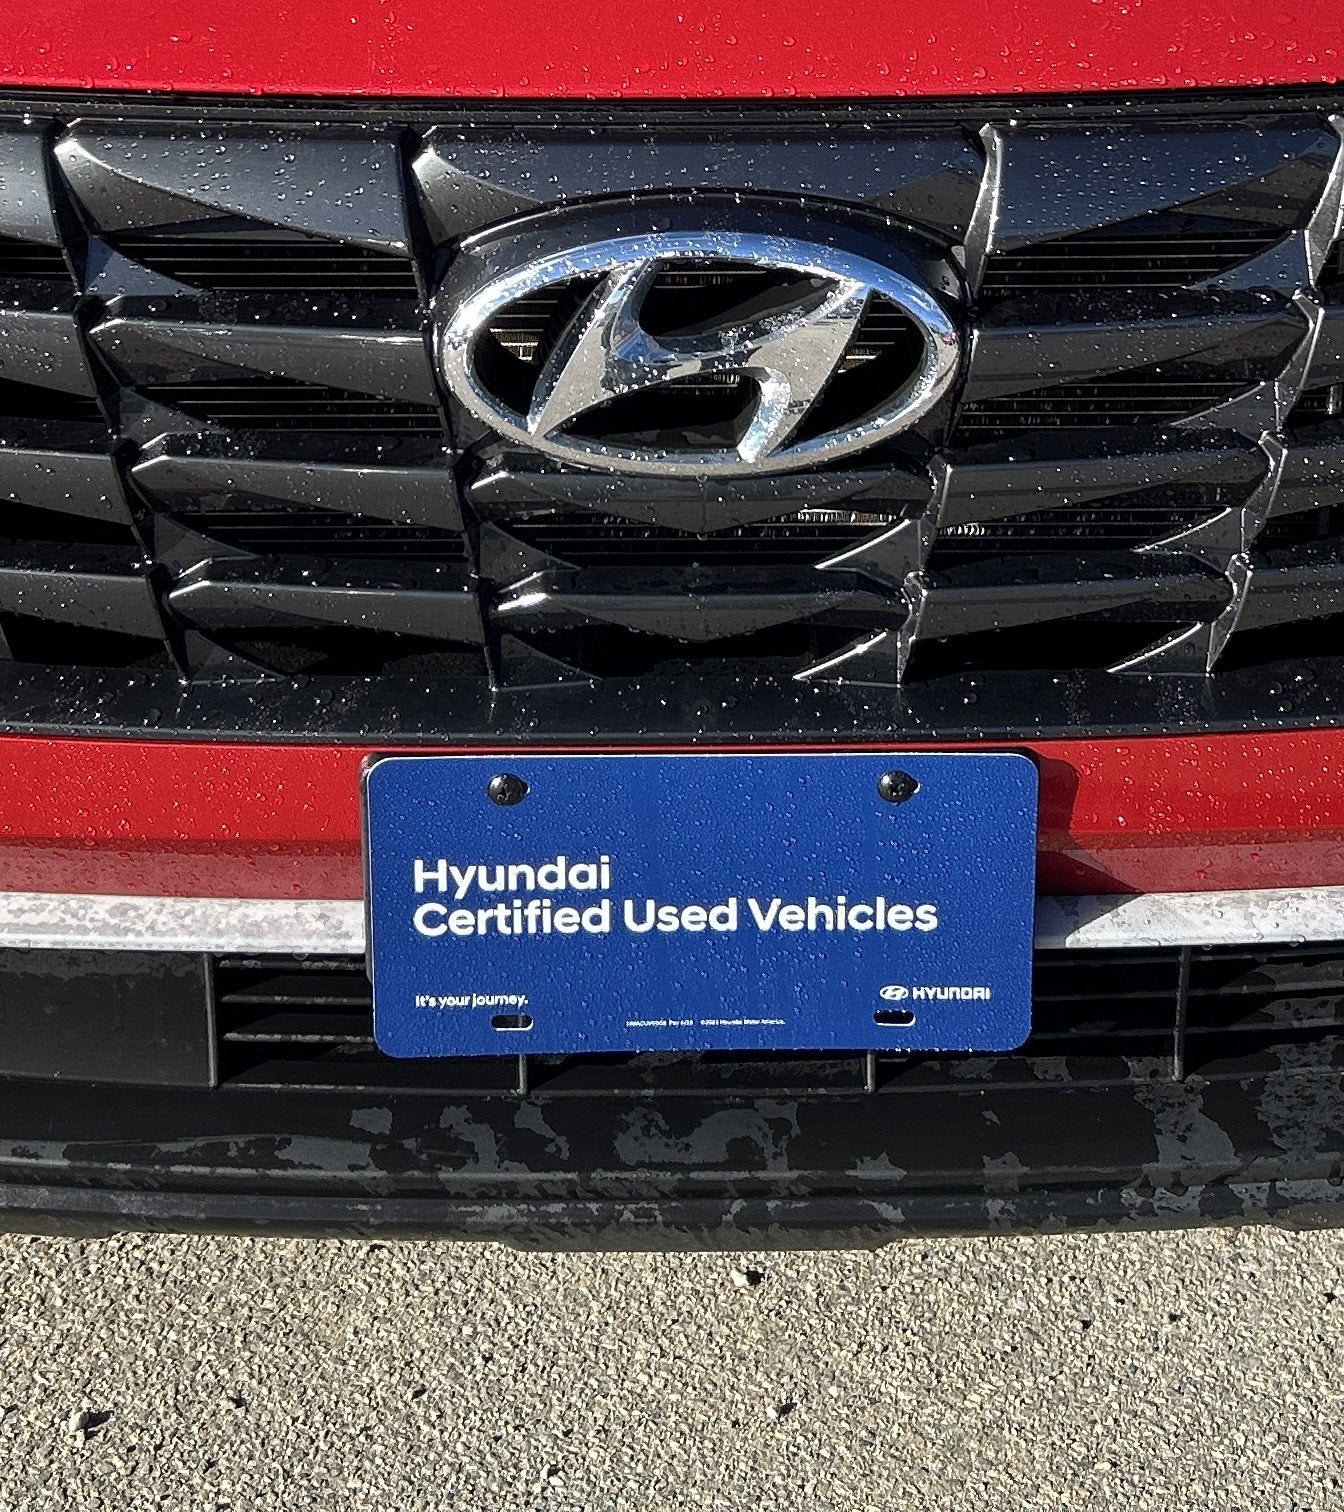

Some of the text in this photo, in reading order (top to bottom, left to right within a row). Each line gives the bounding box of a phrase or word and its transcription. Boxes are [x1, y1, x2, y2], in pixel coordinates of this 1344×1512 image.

[413, 855, 611, 900] Hyundai
[413, 895, 939, 937] Certified Used Vehicles
[415, 992, 529, 1009] It's your journey.
[912, 986, 992, 1001] HYUNDAI
